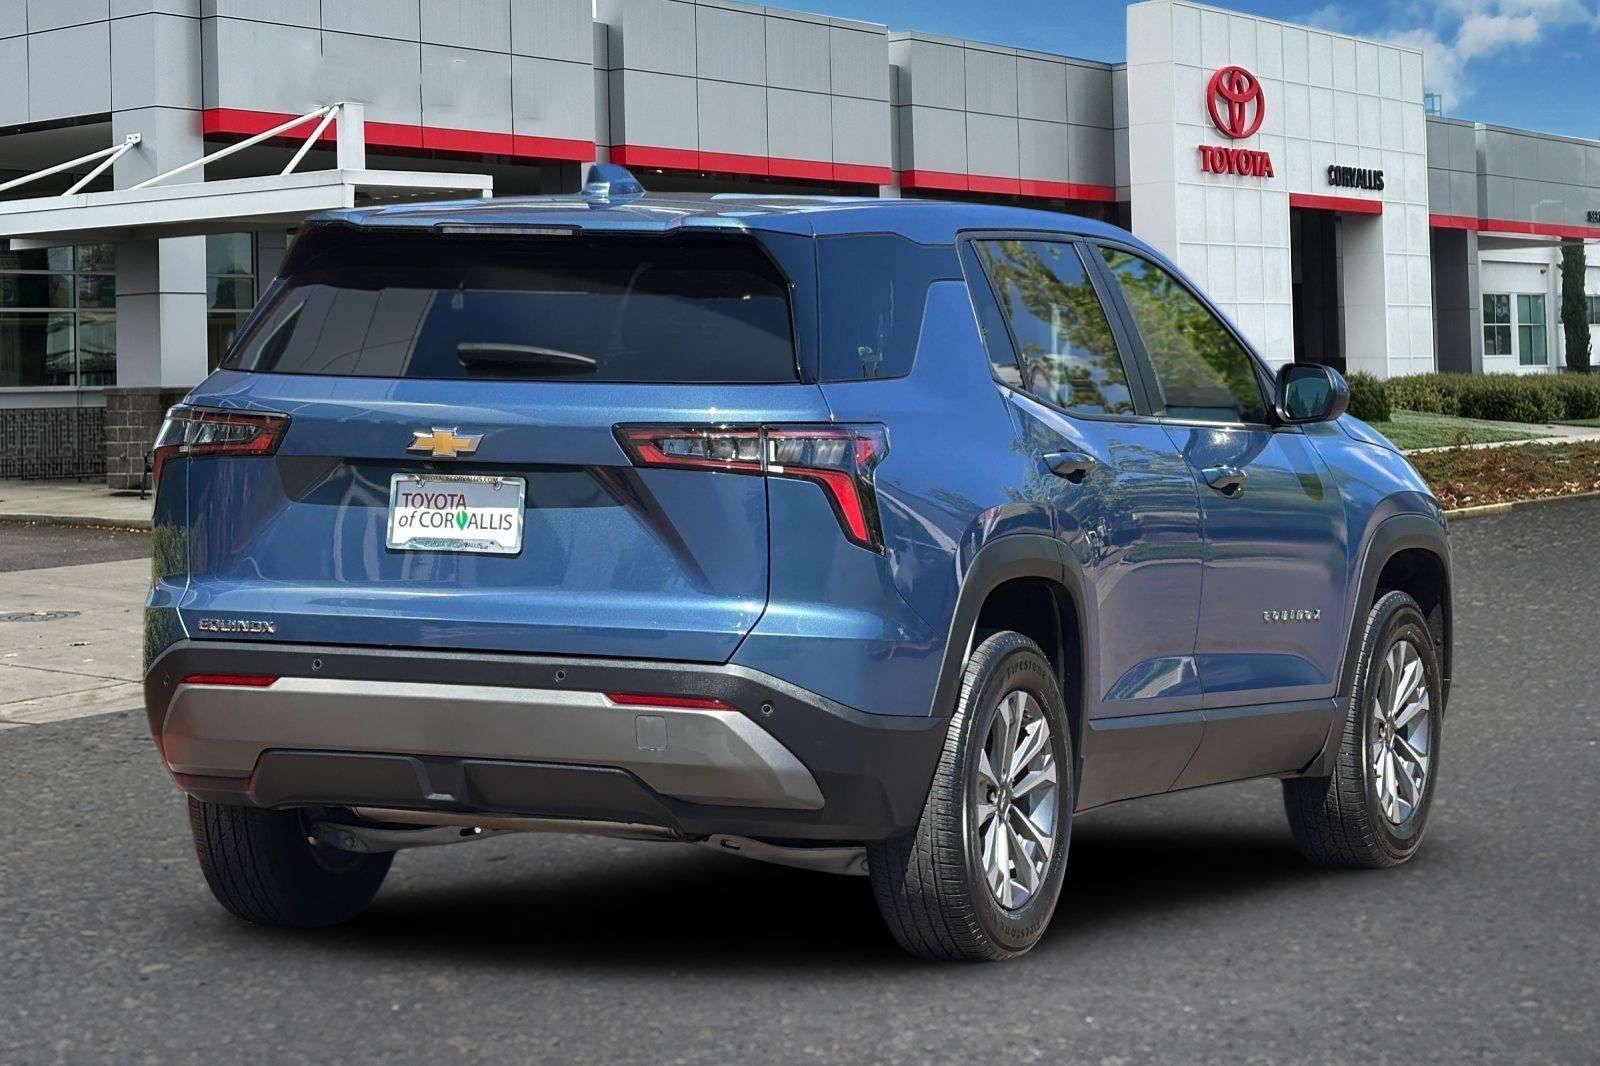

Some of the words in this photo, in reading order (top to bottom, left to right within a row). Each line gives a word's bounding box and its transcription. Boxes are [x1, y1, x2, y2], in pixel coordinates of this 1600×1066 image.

[1198, 145, 1274, 178] TOYOTA
[1327, 164, 1384, 191] CORVALLIS
[402, 493, 467, 510] TOYOTA
[398, 510, 418, 528] of
[419, 510, 513, 531] CORVALLIS
[1263, 609, 1321, 621] EQUINOX
[198, 619, 276, 634] EQUINOX
